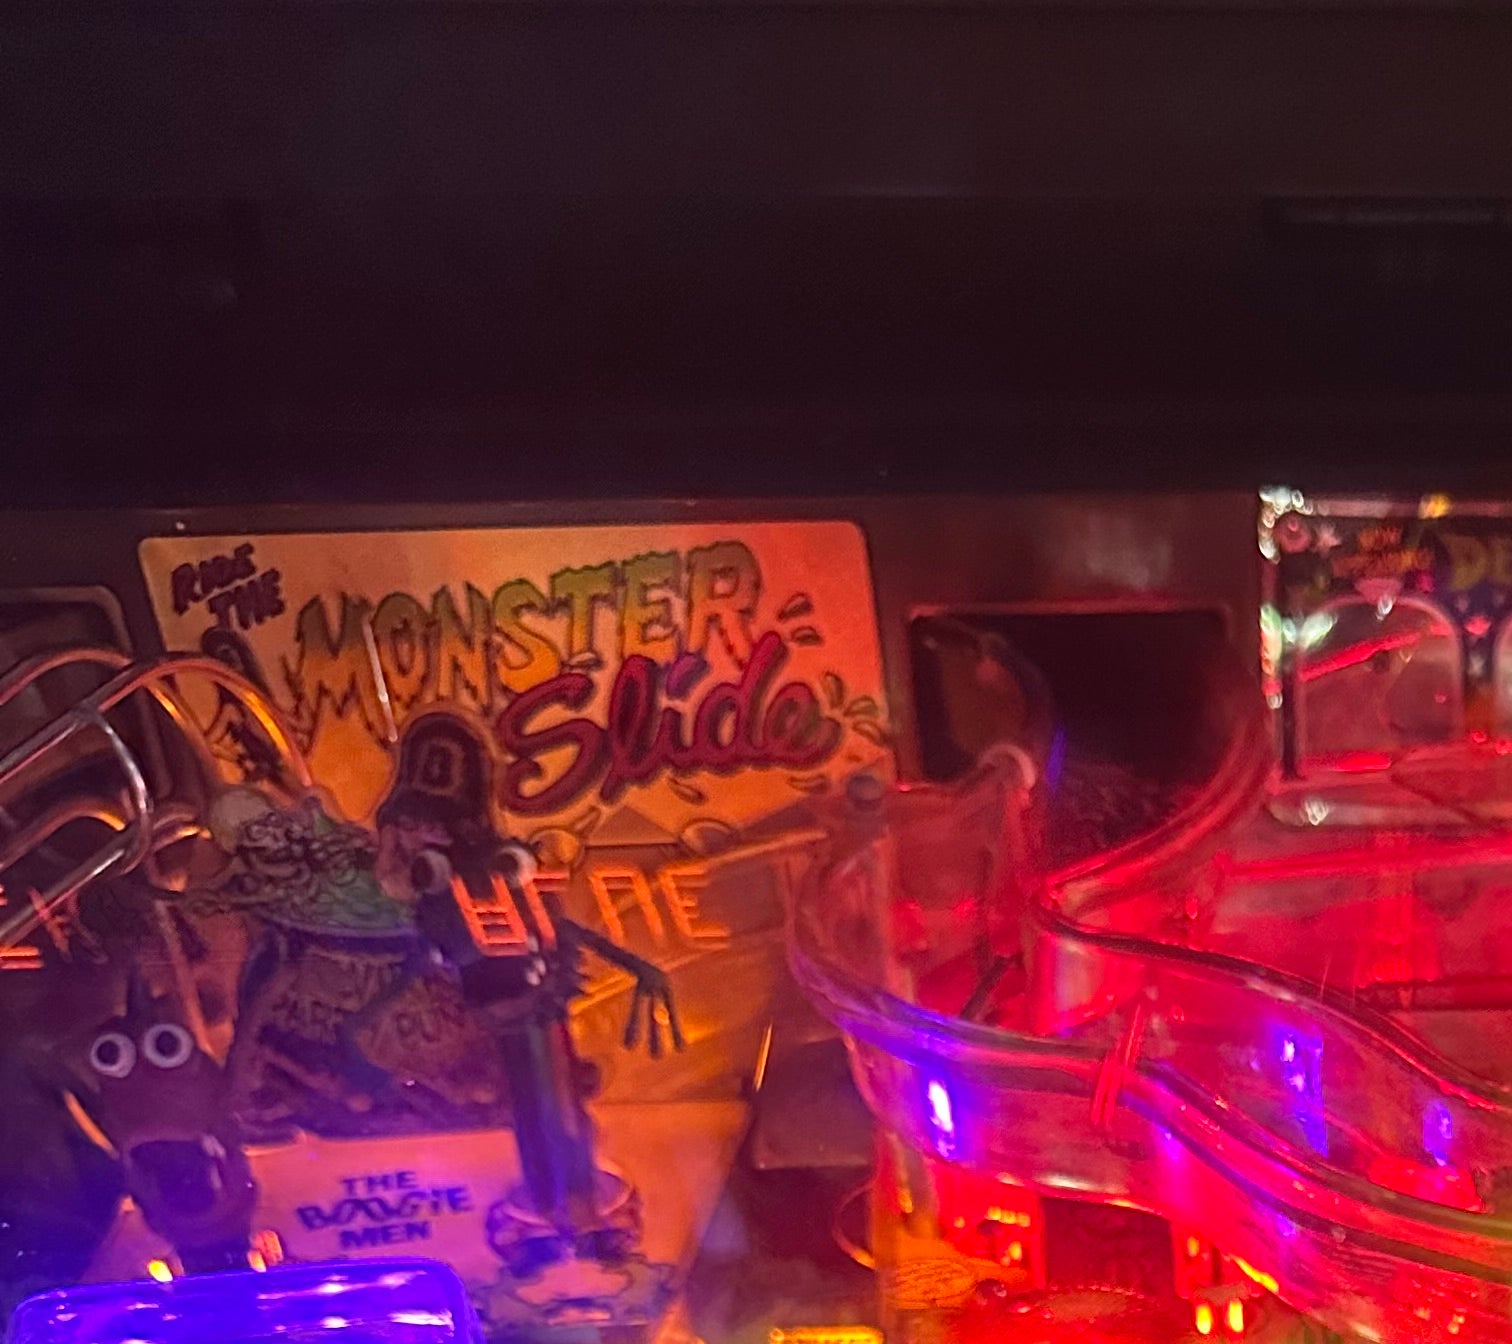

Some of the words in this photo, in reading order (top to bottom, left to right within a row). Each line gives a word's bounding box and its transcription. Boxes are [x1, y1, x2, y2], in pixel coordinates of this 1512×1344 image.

[207, 566, 286, 631] THE
[291, 540, 766, 742] MONSTER
[498, 630, 844, 817] Slide
[296, 1186, 475, 1231] BOOGIE
[340, 1169, 419, 1196] THE
[339, 1220, 434, 1250] MEN
